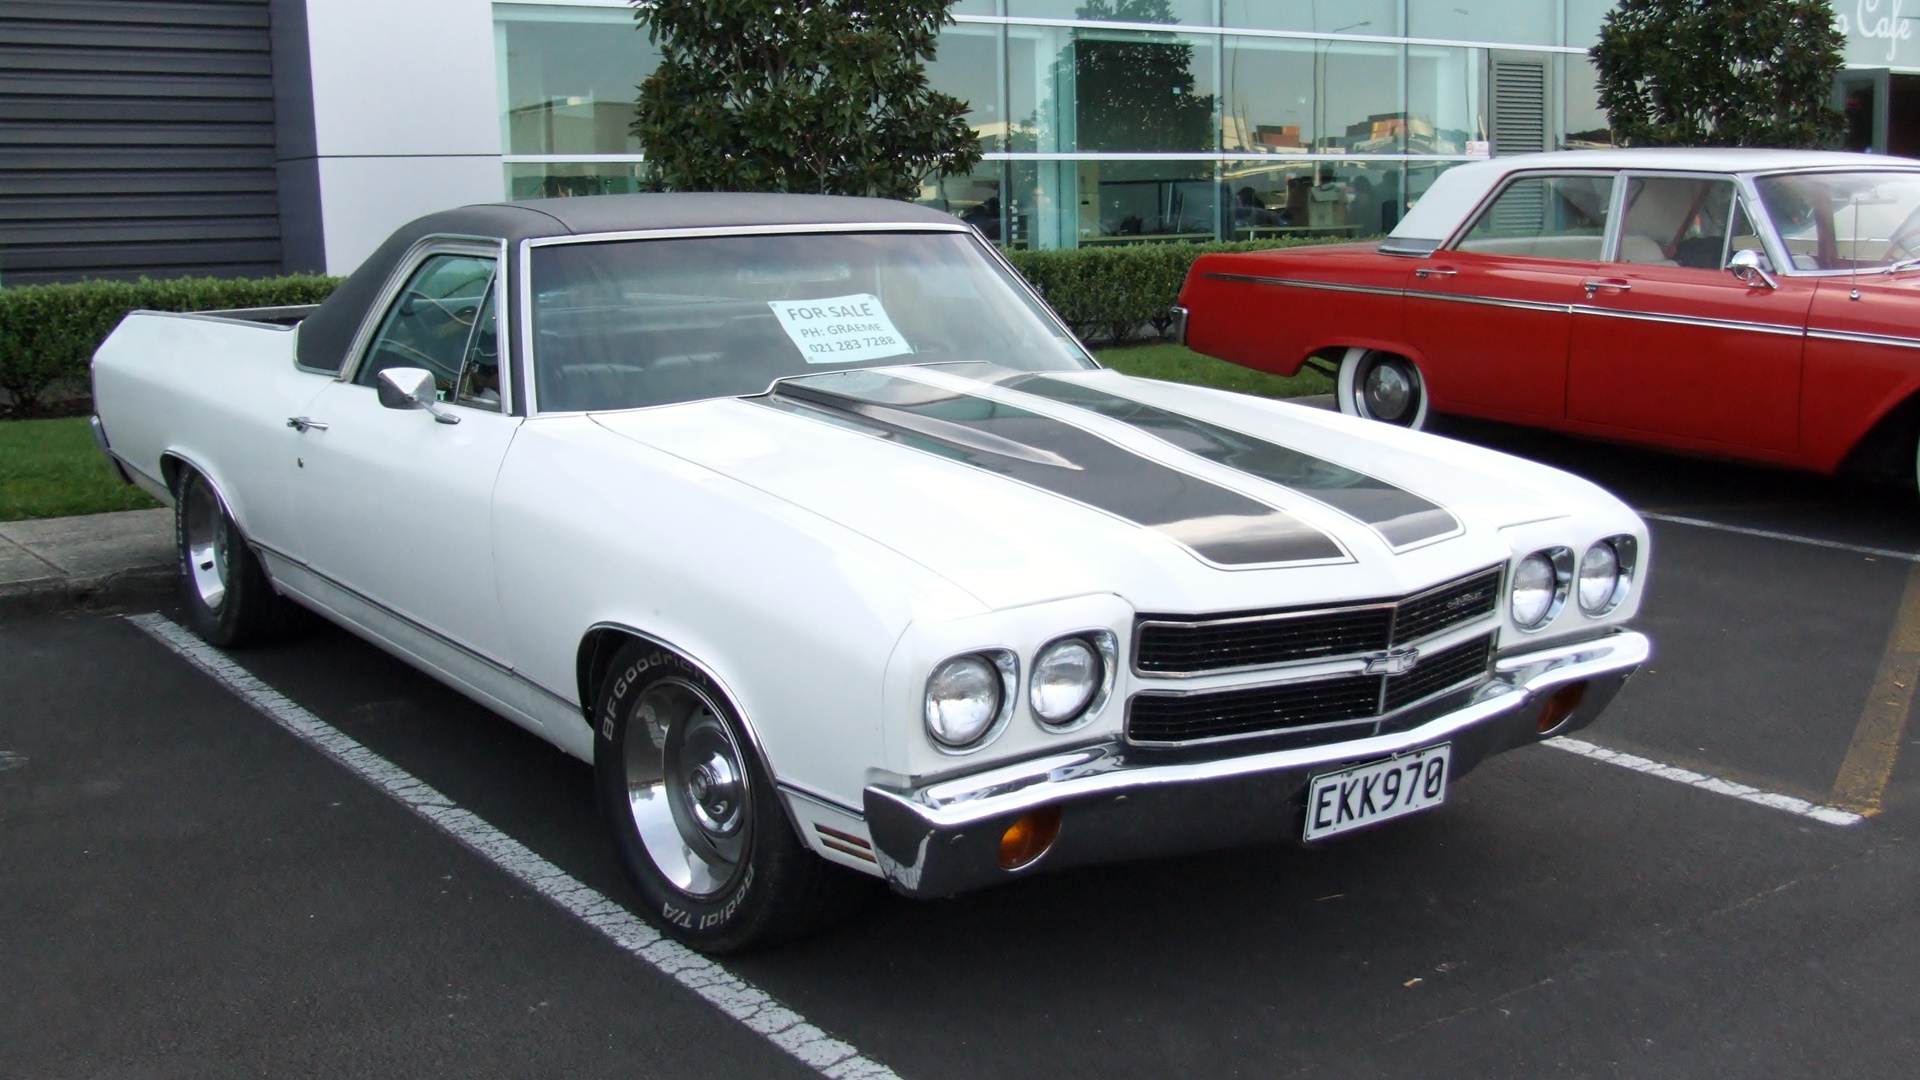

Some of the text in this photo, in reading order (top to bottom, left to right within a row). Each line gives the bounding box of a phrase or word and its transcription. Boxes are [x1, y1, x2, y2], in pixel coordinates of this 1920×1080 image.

[787, 303, 874, 321] FOR SALE
[800, 323, 883, 338] PH: GRAEME
[809, 336, 896, 353] 021 283 7288
[1313, 756, 1444, 830] EKK970
